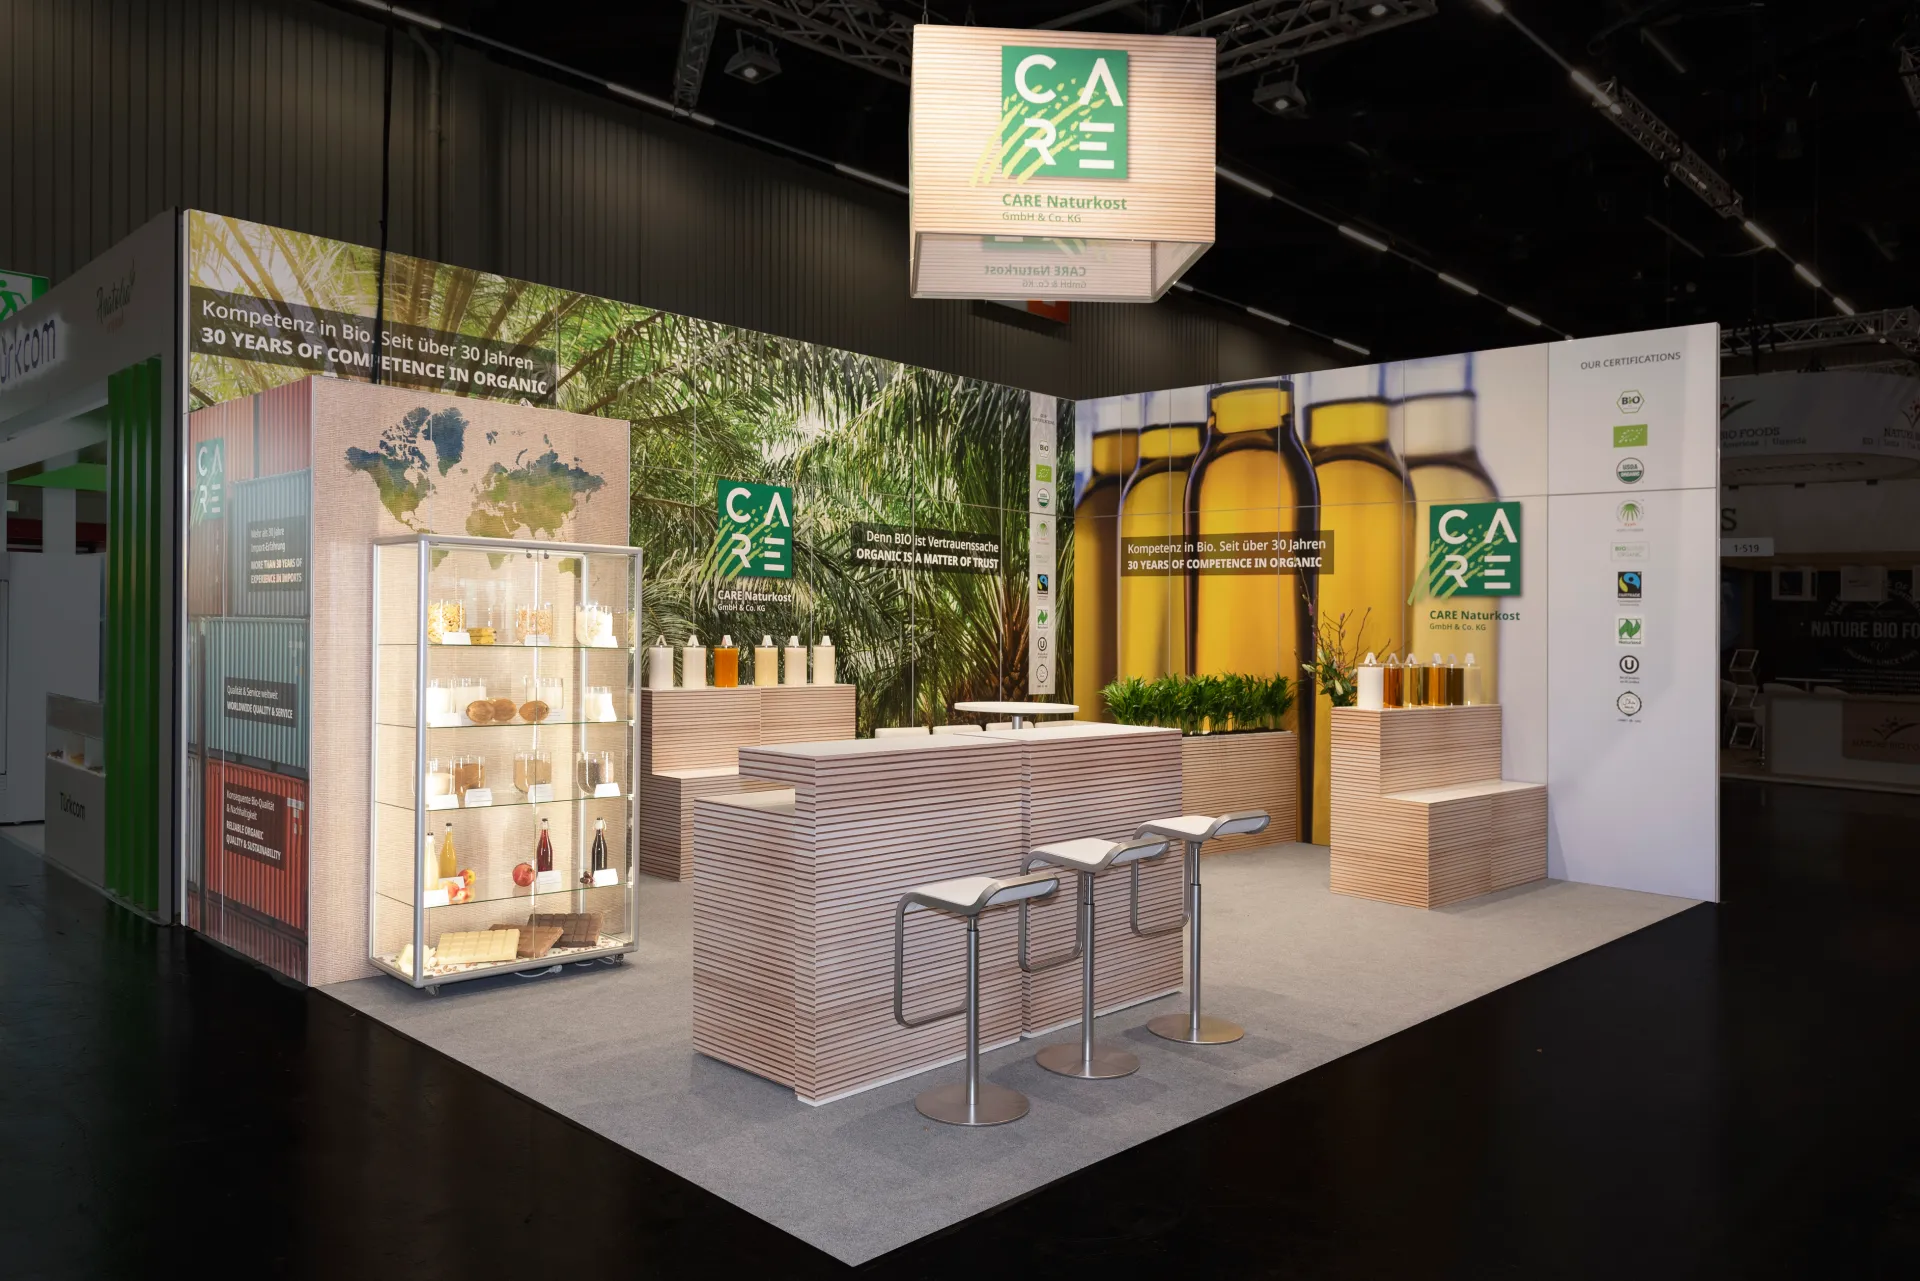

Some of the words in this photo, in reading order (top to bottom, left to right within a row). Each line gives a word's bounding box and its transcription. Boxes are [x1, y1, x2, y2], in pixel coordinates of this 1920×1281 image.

[1002, 193, 1042, 208] CARE
[1047, 195, 1127, 210] Naturkost
[1002, 212, 1035, 222] GmbH
[1037, 213, 1046, 222] &
[1048, 213, 1064, 223] Co.
[1067, 214, 1082, 223] KG
[202, 300, 315, 334] Kompetenz
[320, 319, 337, 337] in
[342, 324, 375, 344] Bio.
[381, 331, 413, 350] Seit
[418, 337, 457, 357] über
[461, 345, 480, 361] 30
[482, 349, 534, 371] Jahren
[0, 319, 56, 384] ürkcom
[201, 327, 226, 345] 30
[231, 331, 293, 355] YEARS
[297, 343, 323, 360] OF
[449, 367, 469, 383] IN
[473, 372, 547, 395] ORGANIC
[1580, 360, 1601, 370] OUR
[1603, 351, 1682, 368] CERTIFICATIONS
[866, 530, 892, 543] Denn
[894, 533, 911, 545] BIO
[915, 535, 926, 547] ist
[928, 536, 999, 553] Vertrauenssache
[1127, 543, 1182, 557] Kompetenz
[1184, 542, 1194, 553] in
[1197, 541, 1216, 553] Bio.
[1219, 540, 1240, 552] Seit
[1242, 539, 1269, 551] über
[1271, 539, 1287, 550] 30
[1288, 538, 1326, 553] Jahren
[251, 561, 264, 570] MORE
[264, 559, 276, 569] THAN
[281, 558, 295, 568] YEARS
[296, 558, 302, 567] OF
[856, 548, 902, 561] ORGANIC
[903, 552, 912, 563] IS
[914, 552, 923, 563] A
[923, 553, 958, 566] MATTER
[959, 556, 971, 567] OF
[973, 557, 999, 569] TRUST
[1127, 560, 1139, 570] 30
[1140, 560, 1169, 570] YEARS
[1171, 559, 1185, 569] OF
[1186, 558, 1252, 569] COMPETENCE
[1255, 557, 1268, 568] IN
[1269, 556, 1323, 568] ORGANIC
[251, 574, 276, 584] EXPERIENCE
[282, 572, 302, 583] IMPORTS
[717, 591, 742, 601] CARE
[745, 591, 792, 602] Naturkost
[717, 603, 738, 611] GmbH
[745, 604, 756, 612] Co.
[1429, 610, 1458, 620] CARE
[1461, 610, 1521, 621] Naturkost
[1810, 620, 1870, 639] NATURE
[1872, 621, 1898, 639] BIO
[1901, 621, 1920, 640] FO
[227, 685, 243, 696] Qualität
[246, 687, 261, 698] Service
[261, 689, 278, 700] weltweit
[227, 701, 253, 713] WORLDWIDE
[253, 704, 271, 715] QUALITY
[271, 707, 276, 716] &
[275, 707, 293, 719] SERVICE
[226, 790, 251, 804] Konsequente
[251, 796, 275, 811] Bio-Qualität
[226, 820, 245, 835] RELIABLE
[244, 826, 264, 840] ORGANIC
[226, 834, 243, 848] QUALITY
[247, 841, 281, 860] SUSTAINABILITY
